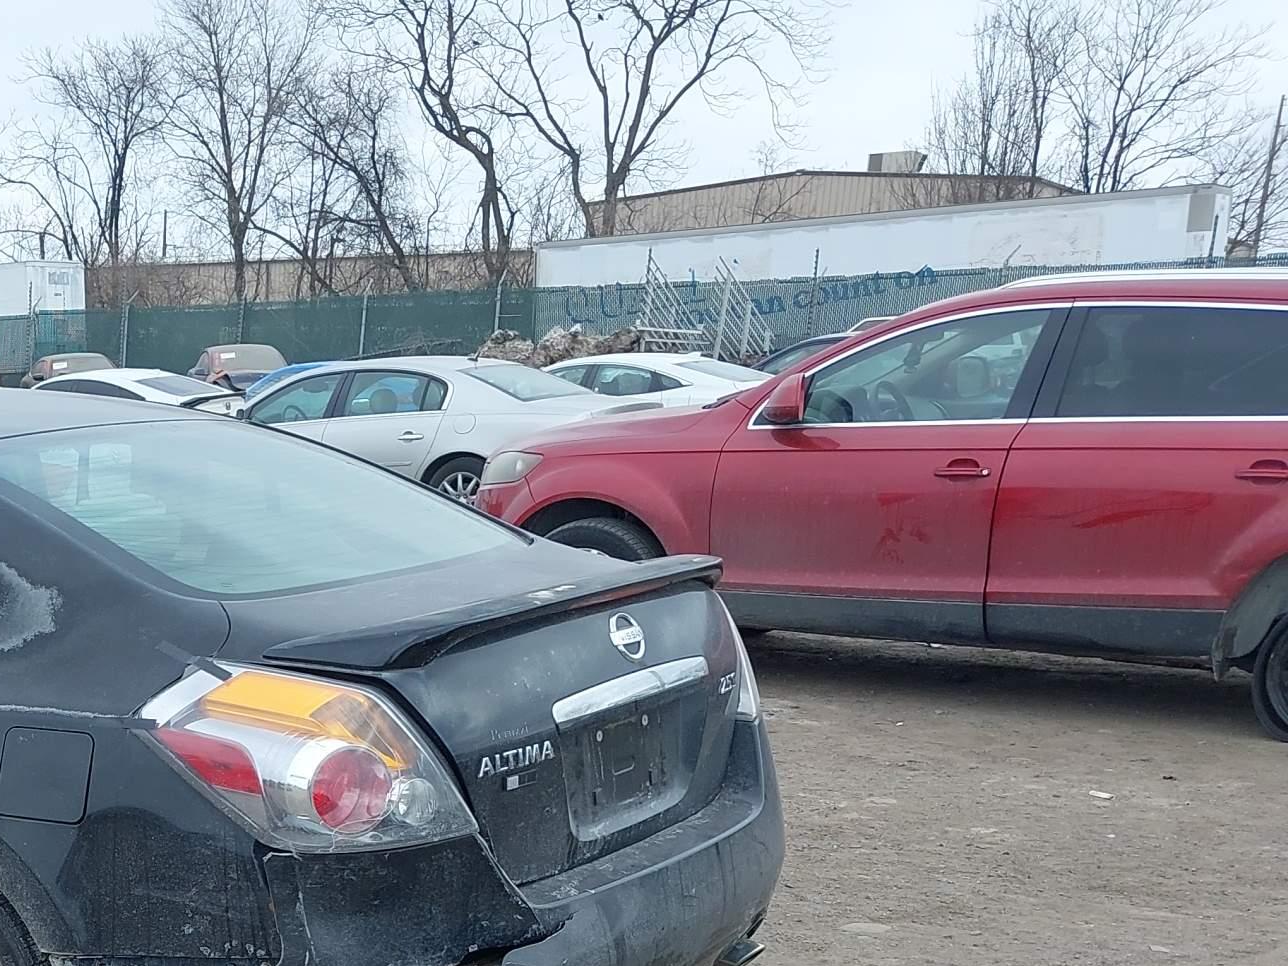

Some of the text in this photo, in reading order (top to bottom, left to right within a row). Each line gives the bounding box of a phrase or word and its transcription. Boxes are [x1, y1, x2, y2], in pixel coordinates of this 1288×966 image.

[793, 271, 885, 309] count
[893, 267, 938, 289] on
[477, 739, 556, 778] ALTIMA
